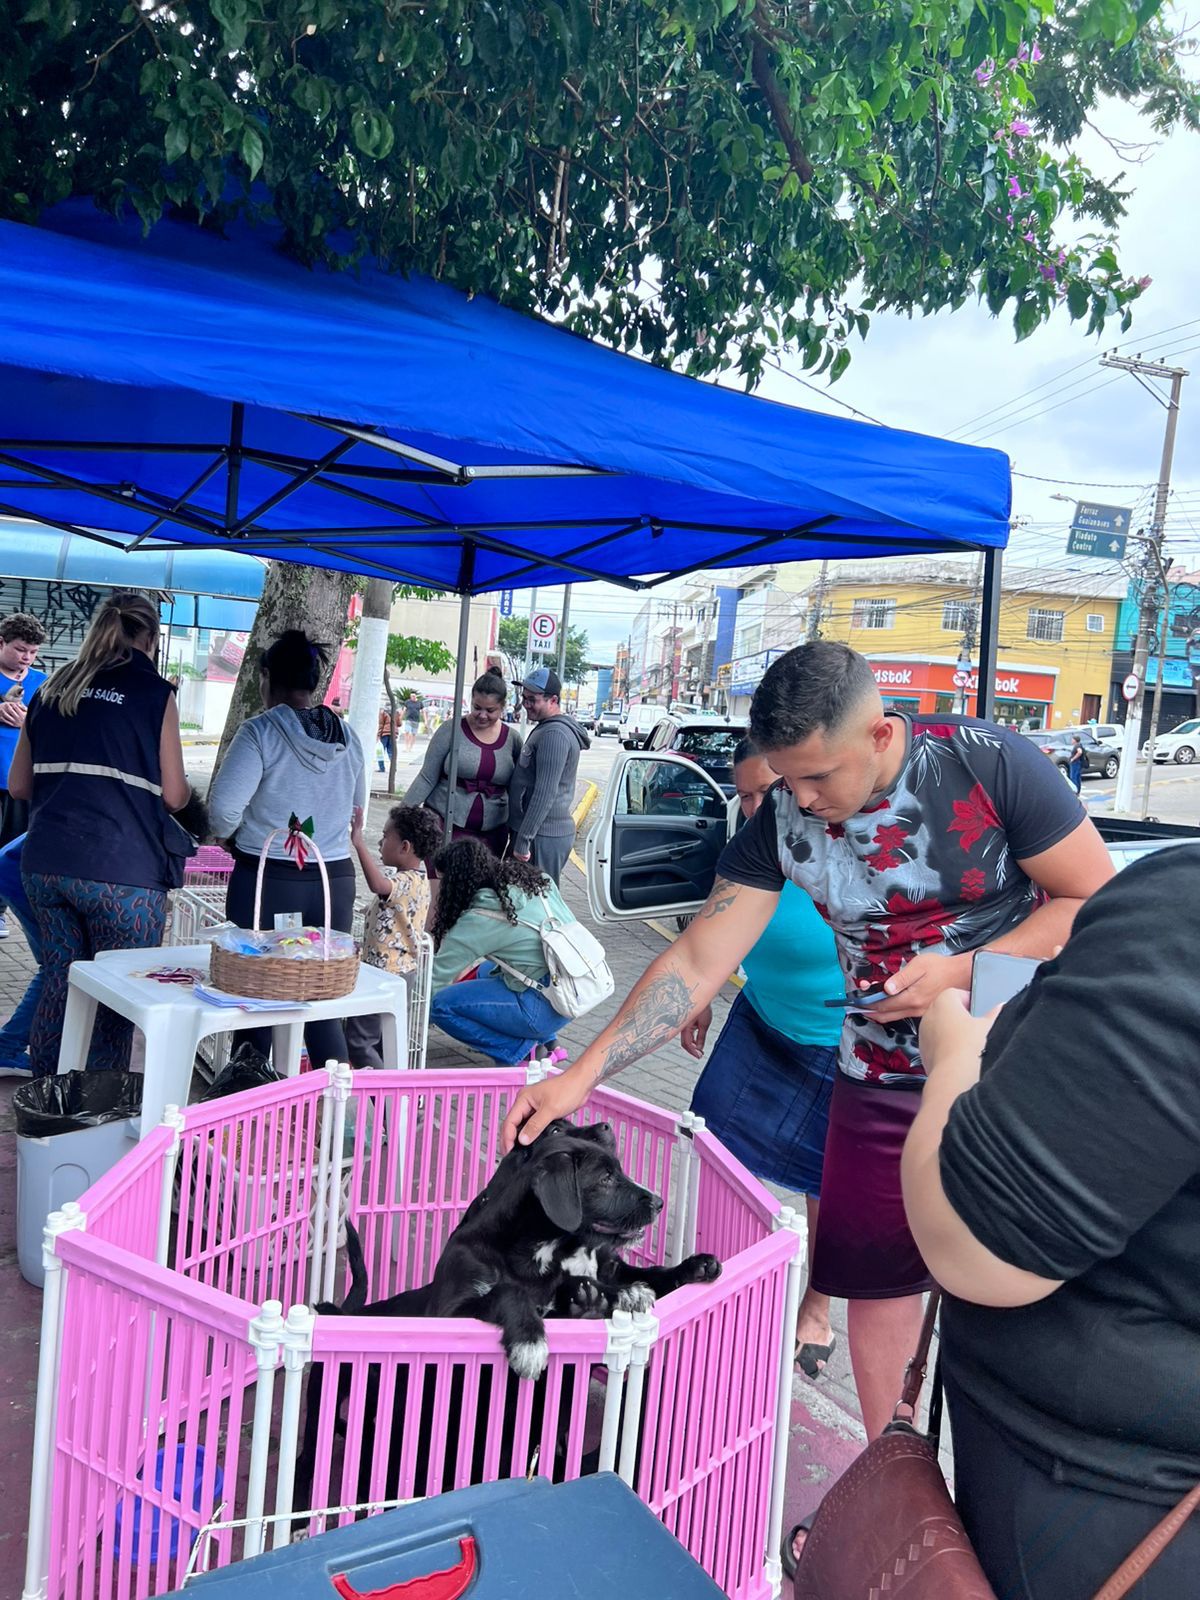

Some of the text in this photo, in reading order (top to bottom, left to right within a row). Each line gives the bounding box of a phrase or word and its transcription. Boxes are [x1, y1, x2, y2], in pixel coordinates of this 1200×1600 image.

[1072, 540, 1092, 552] Centro
[539, 619, 548, 634] E
[533, 639, 551, 649] TAXI
[94, 687, 125, 705] SAÚDE
